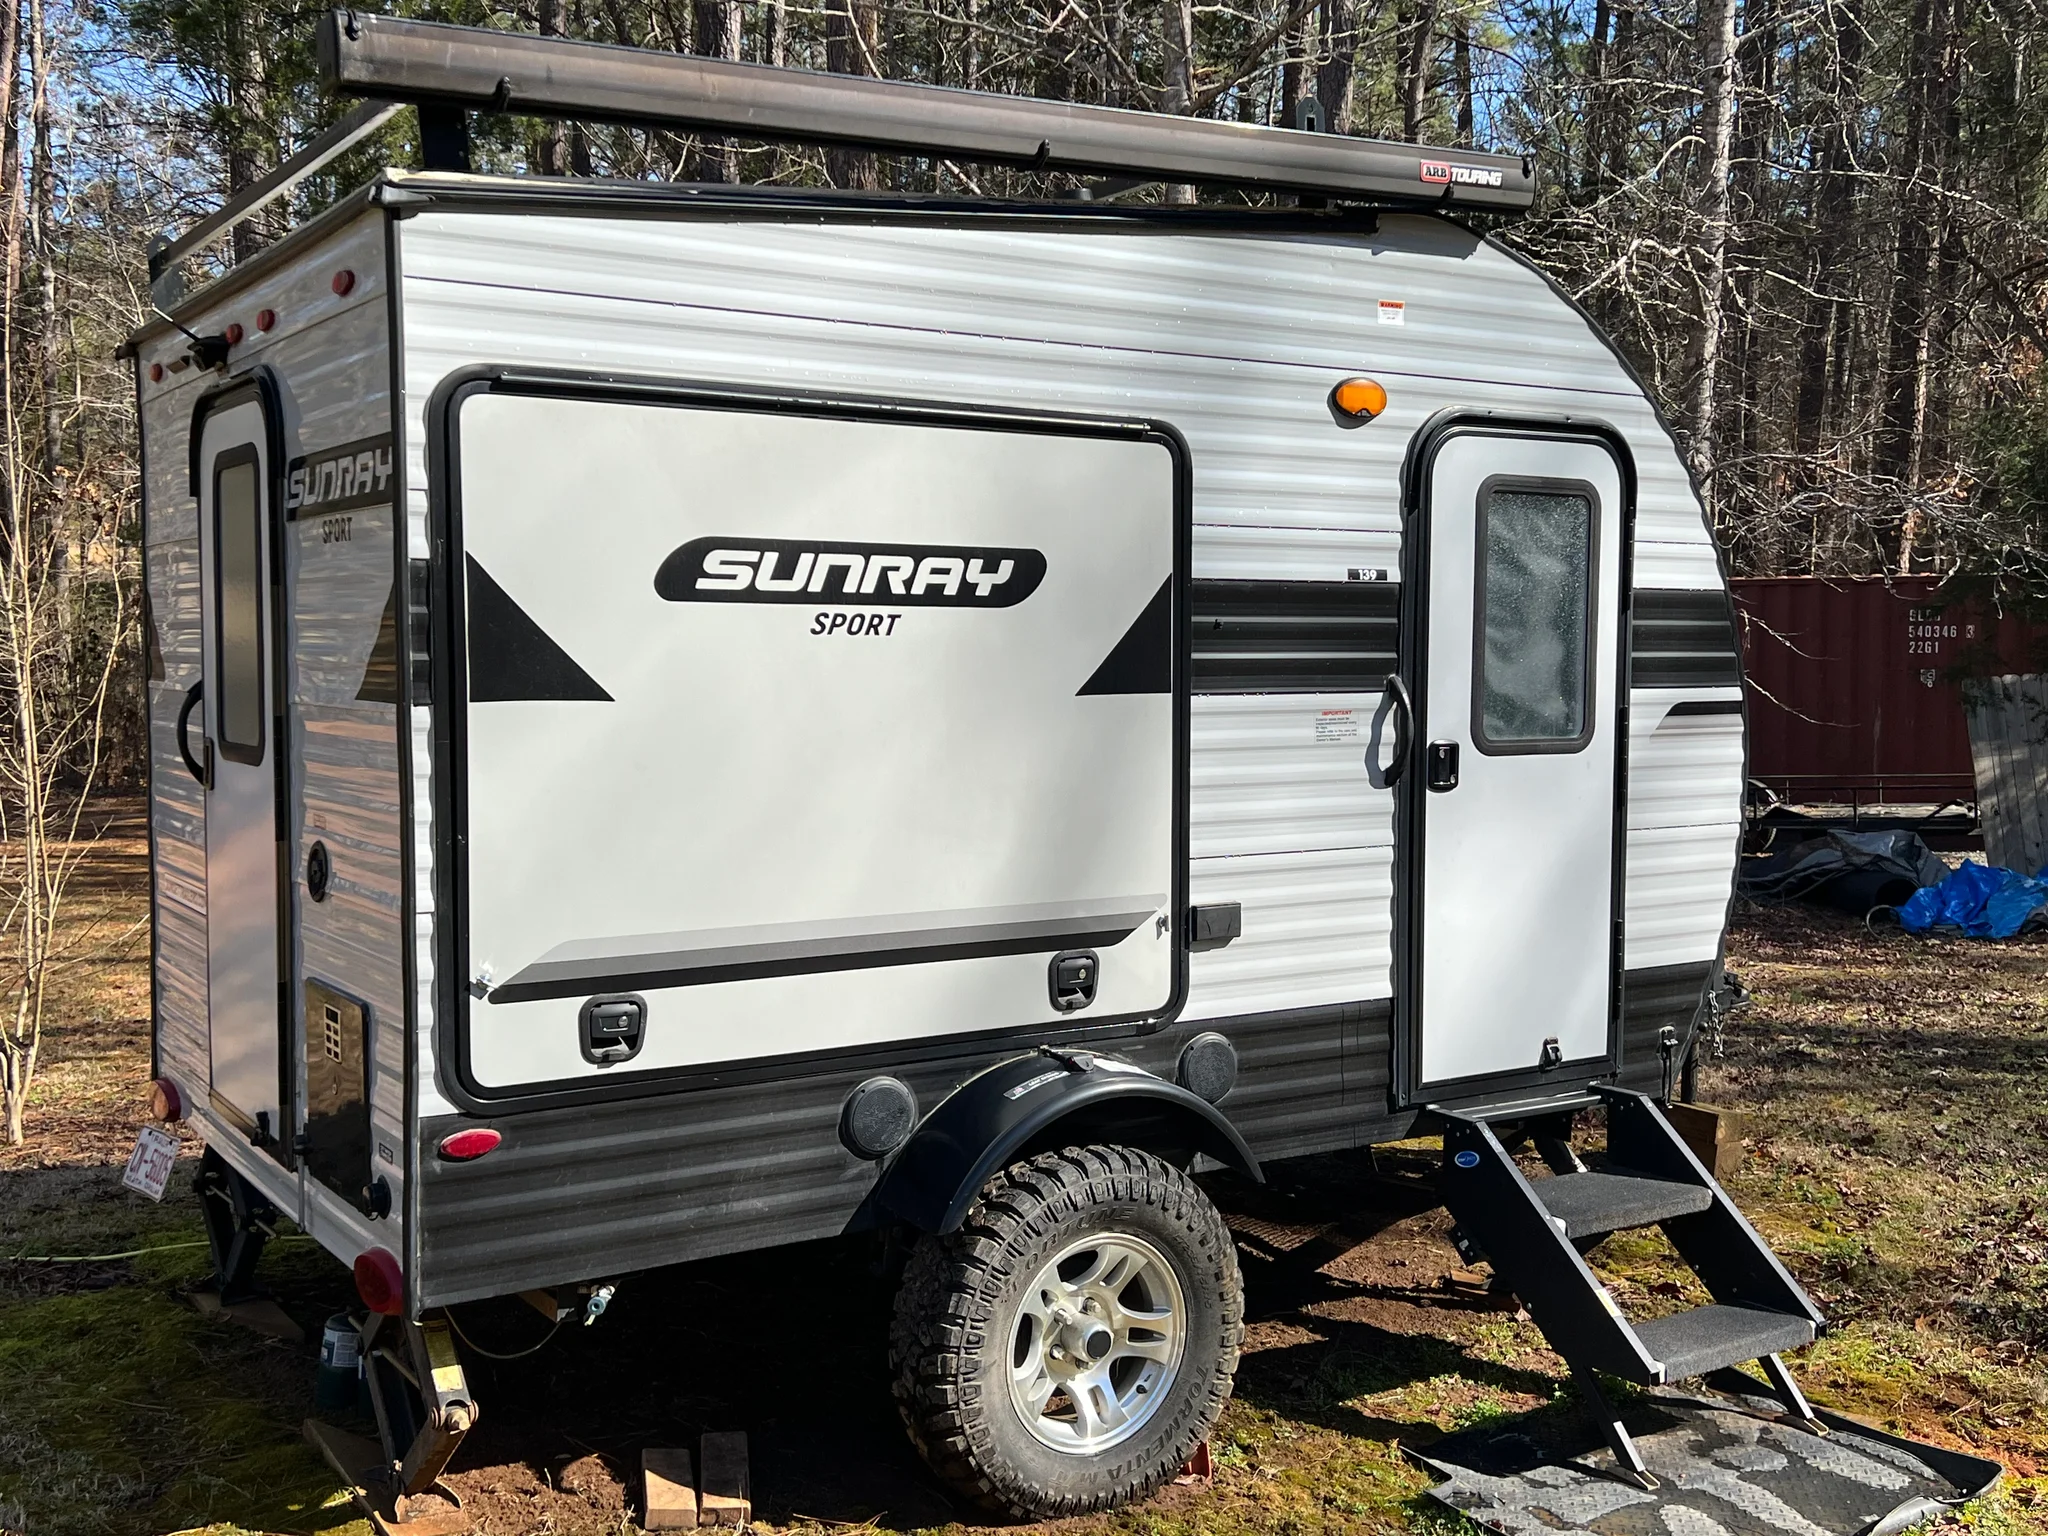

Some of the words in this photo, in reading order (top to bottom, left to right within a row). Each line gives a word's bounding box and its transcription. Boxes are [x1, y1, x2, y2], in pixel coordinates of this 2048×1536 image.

[1425, 166, 1447, 178] ARB
[1451, 167, 1503, 186] TOURING
[286, 446, 393, 509] SUNRAY
[322, 516, 353, 544] SPORT
[695, 548, 1015, 597] SUNRAY
[1358, 569, 1377, 581] 139
[809, 612, 902, 636] SPORT
[1908, 625, 1957, 638] 540346
[1908, 641, 1939, 654] 22G1
[1105, 1364, 1210, 1482] TORMENTA
